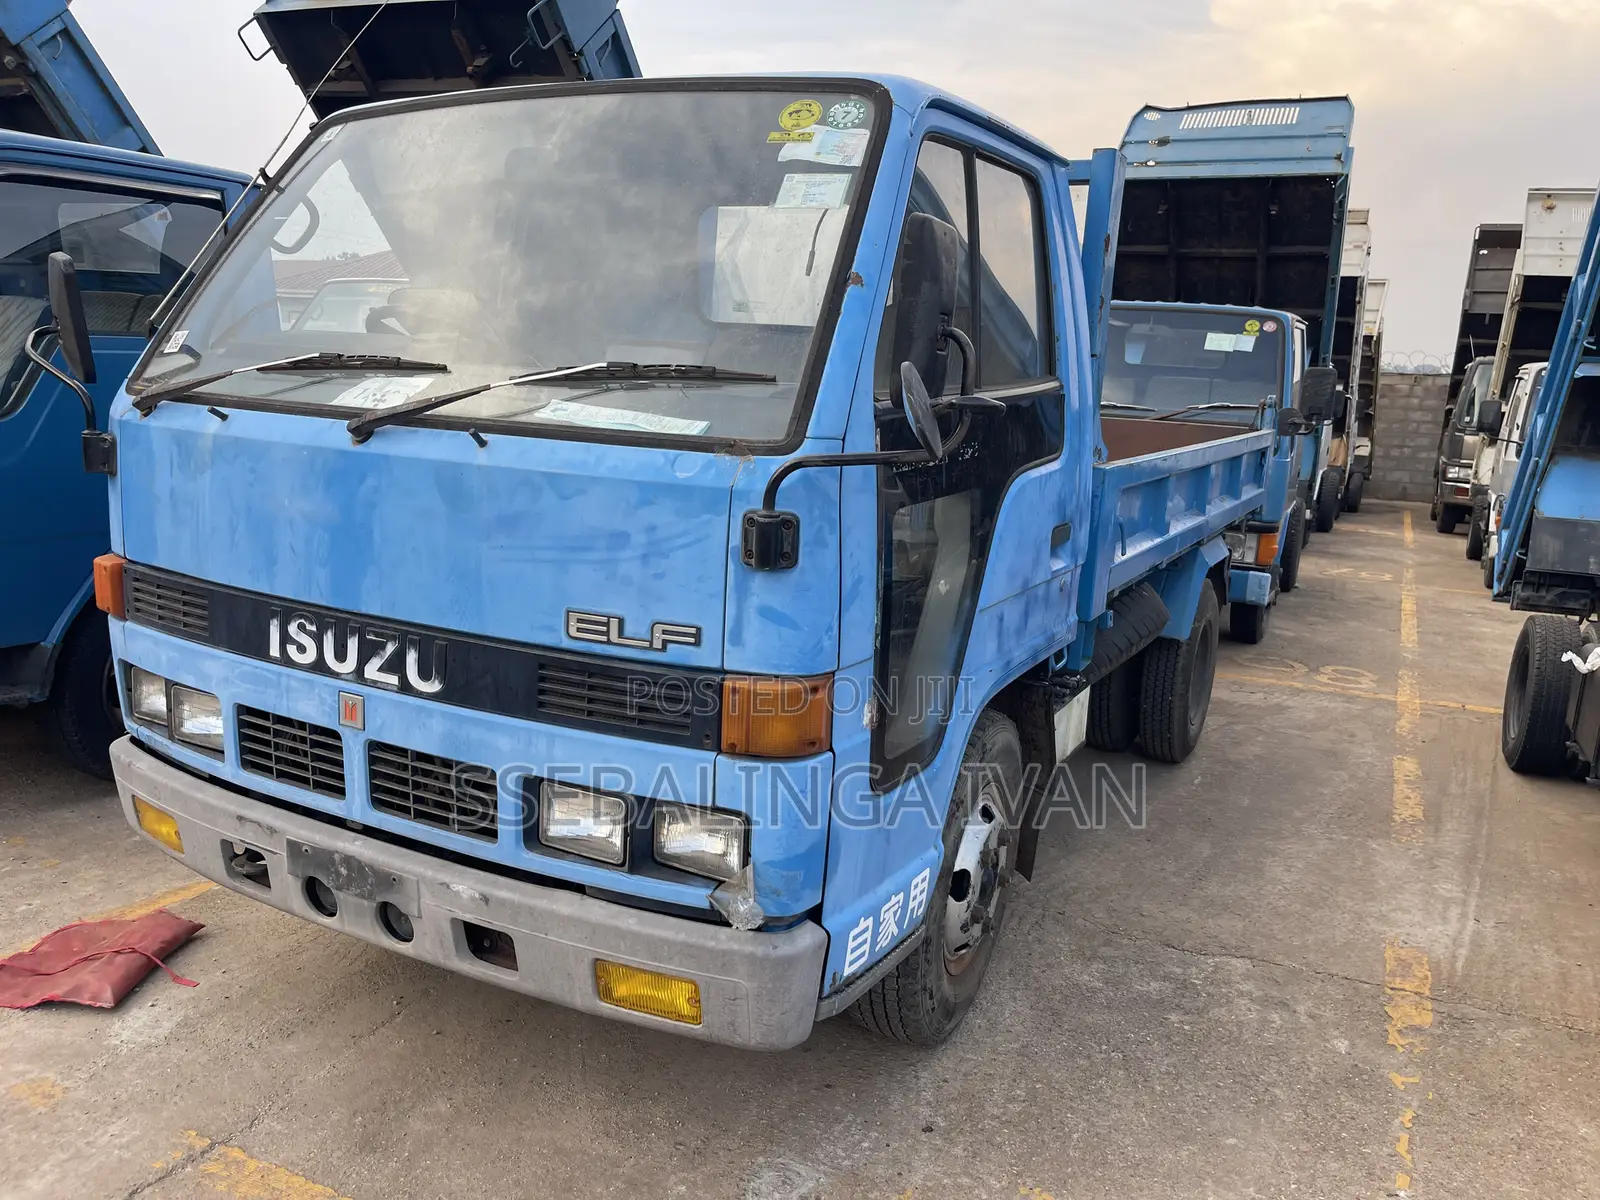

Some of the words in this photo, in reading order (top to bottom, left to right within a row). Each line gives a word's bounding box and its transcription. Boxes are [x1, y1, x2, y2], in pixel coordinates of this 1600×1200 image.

[841, 111, 852, 120] 7
[269, 607, 449, 693] ISUZU
[565, 609, 702, 652] ELF
[843, 867, 930, 976] 自家用
